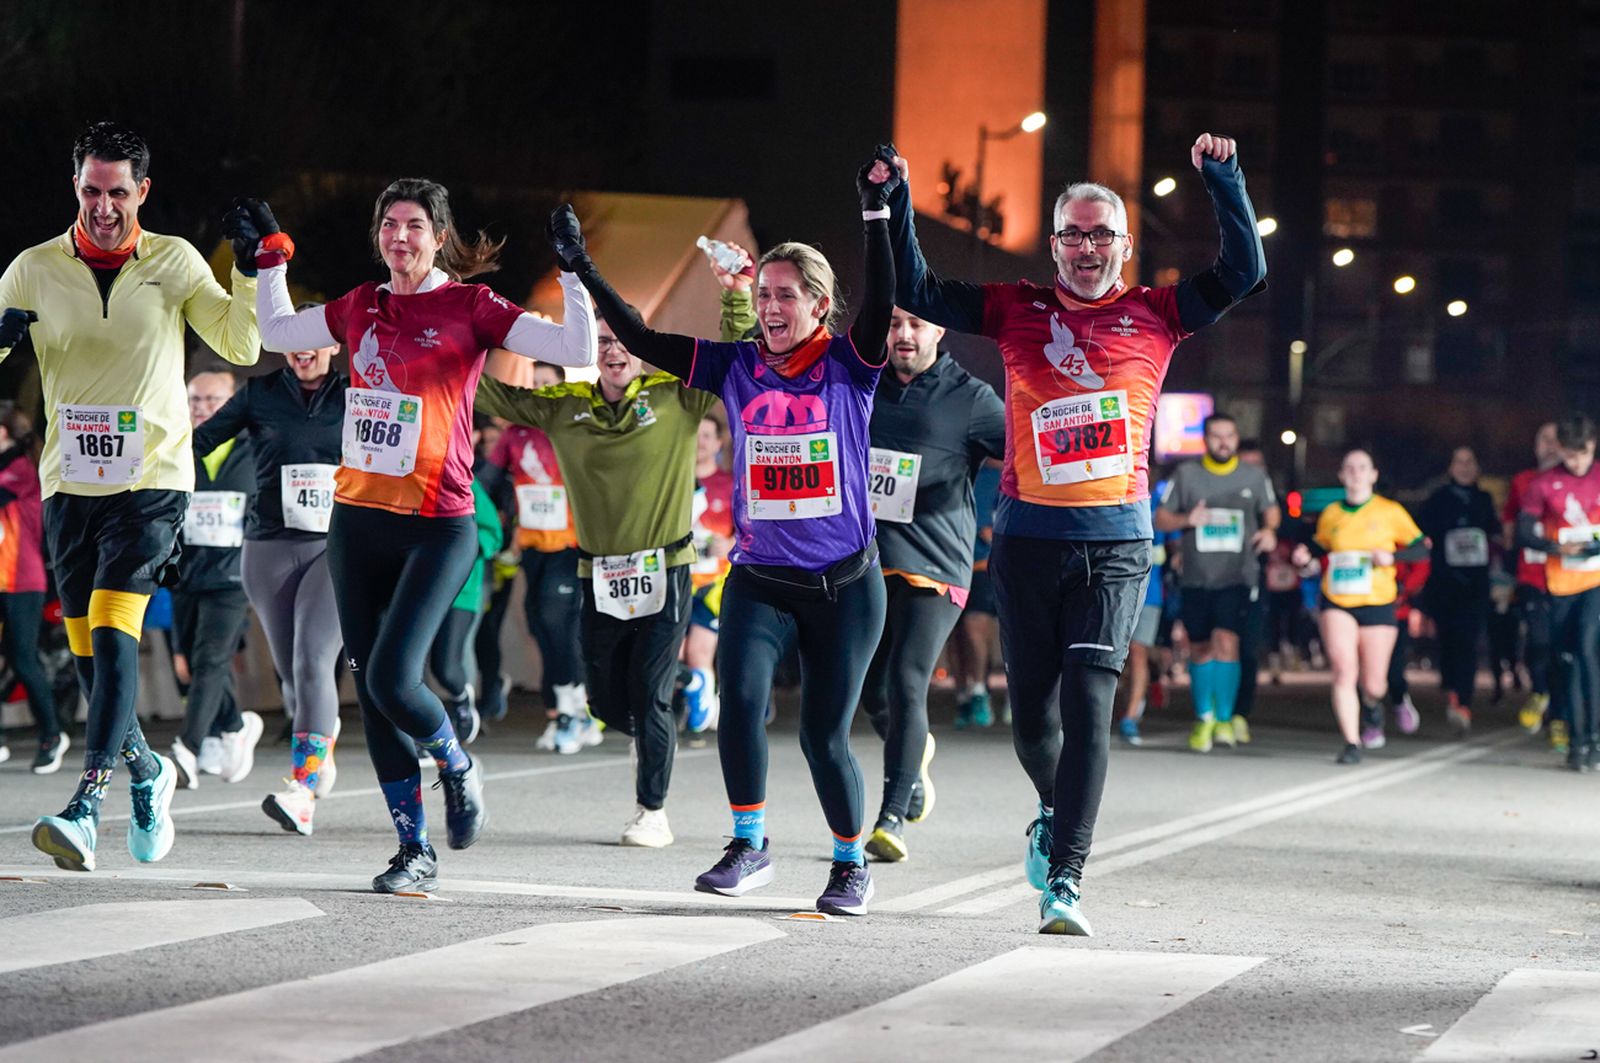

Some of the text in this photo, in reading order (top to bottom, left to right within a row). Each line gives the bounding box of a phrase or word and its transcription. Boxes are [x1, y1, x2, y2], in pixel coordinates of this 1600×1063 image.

[364, 363, 385, 387] 43
[1059, 353, 1085, 377] 43
[381, 401, 392, 410] DE
[1052, 405, 1080, 418] NOCHE
[1081, 403, 1092, 413] DE
[66, 422, 81, 431] SAN
[83, 423, 110, 433] ANTÓN
[74, 414, 99, 423] NOCHE
[100, 414, 110, 423] DE
[1043, 420, 1062, 431] SAN
[1063, 413, 1094, 428] ANTÓN
[355, 418, 402, 448] 1868
[1055, 422, 1113, 455] 9782
[76, 433, 125, 458] 1867
[764, 445, 801, 454] NOCHE DE
[756, 455, 771, 464] SAN
[773, 454, 802, 464] ANTÓN
[764, 465, 820, 491] 9780
[609, 575, 652, 599] 3876
